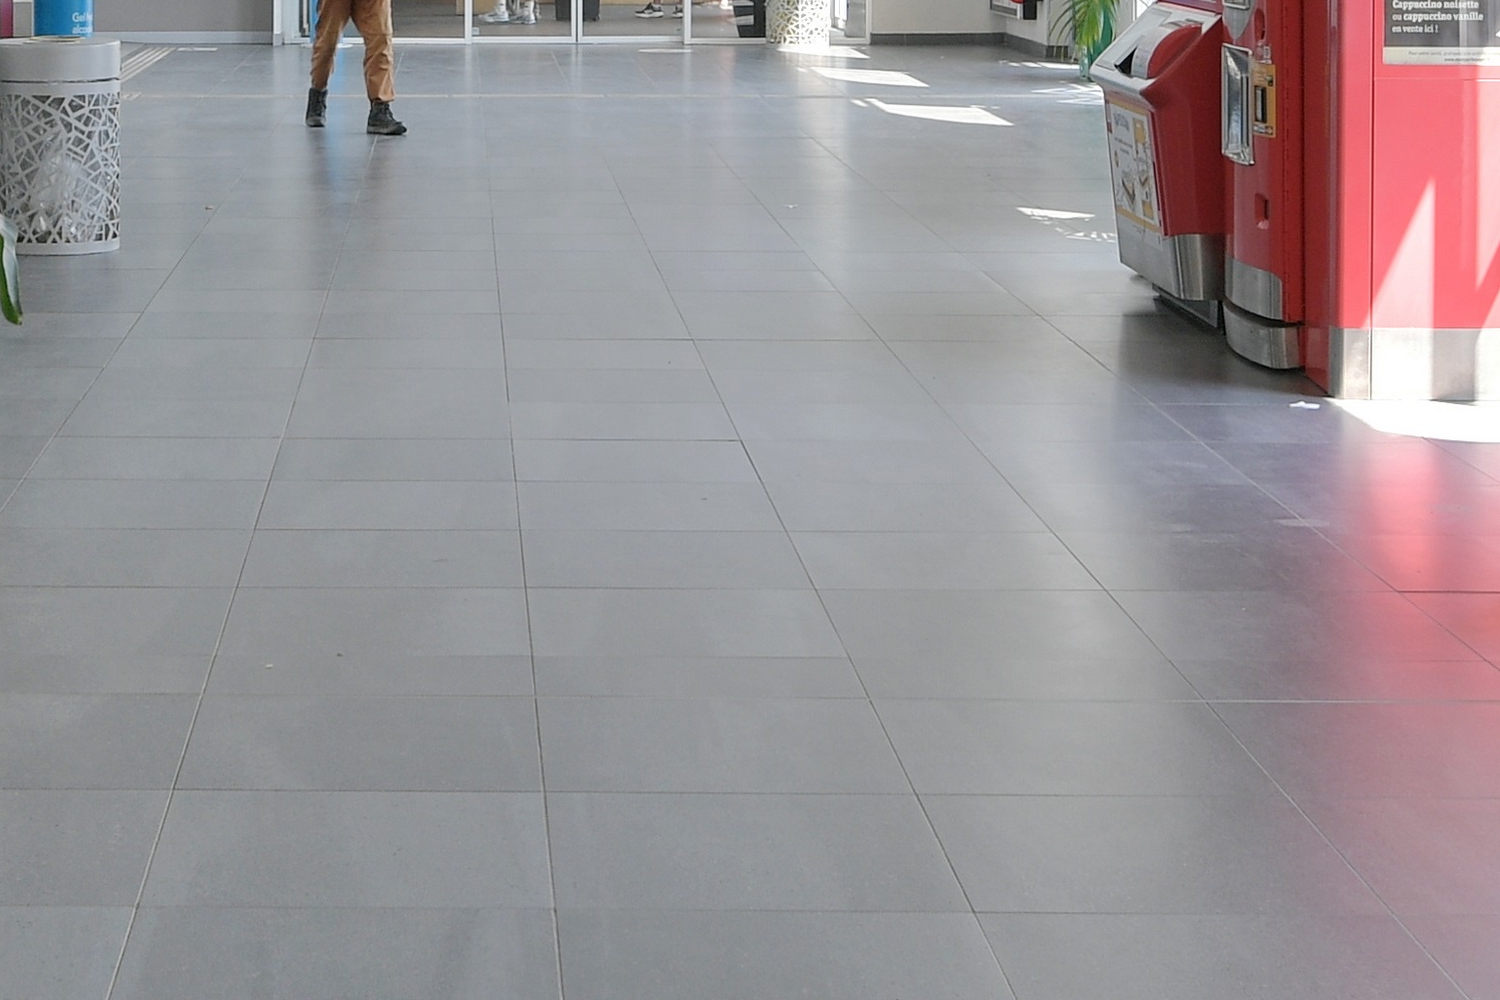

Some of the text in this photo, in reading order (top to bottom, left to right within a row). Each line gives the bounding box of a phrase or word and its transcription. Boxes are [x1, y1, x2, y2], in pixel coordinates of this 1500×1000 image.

[1392, 0, 1480, 10] Cappuccino noisette
[1392, 11, 1484, 22] ou cappuccino vanille
[1392, 25, 1401, 33] en
[1402, 25, 1423, 33] vente
[1424, 24, 1434, 33] ici
